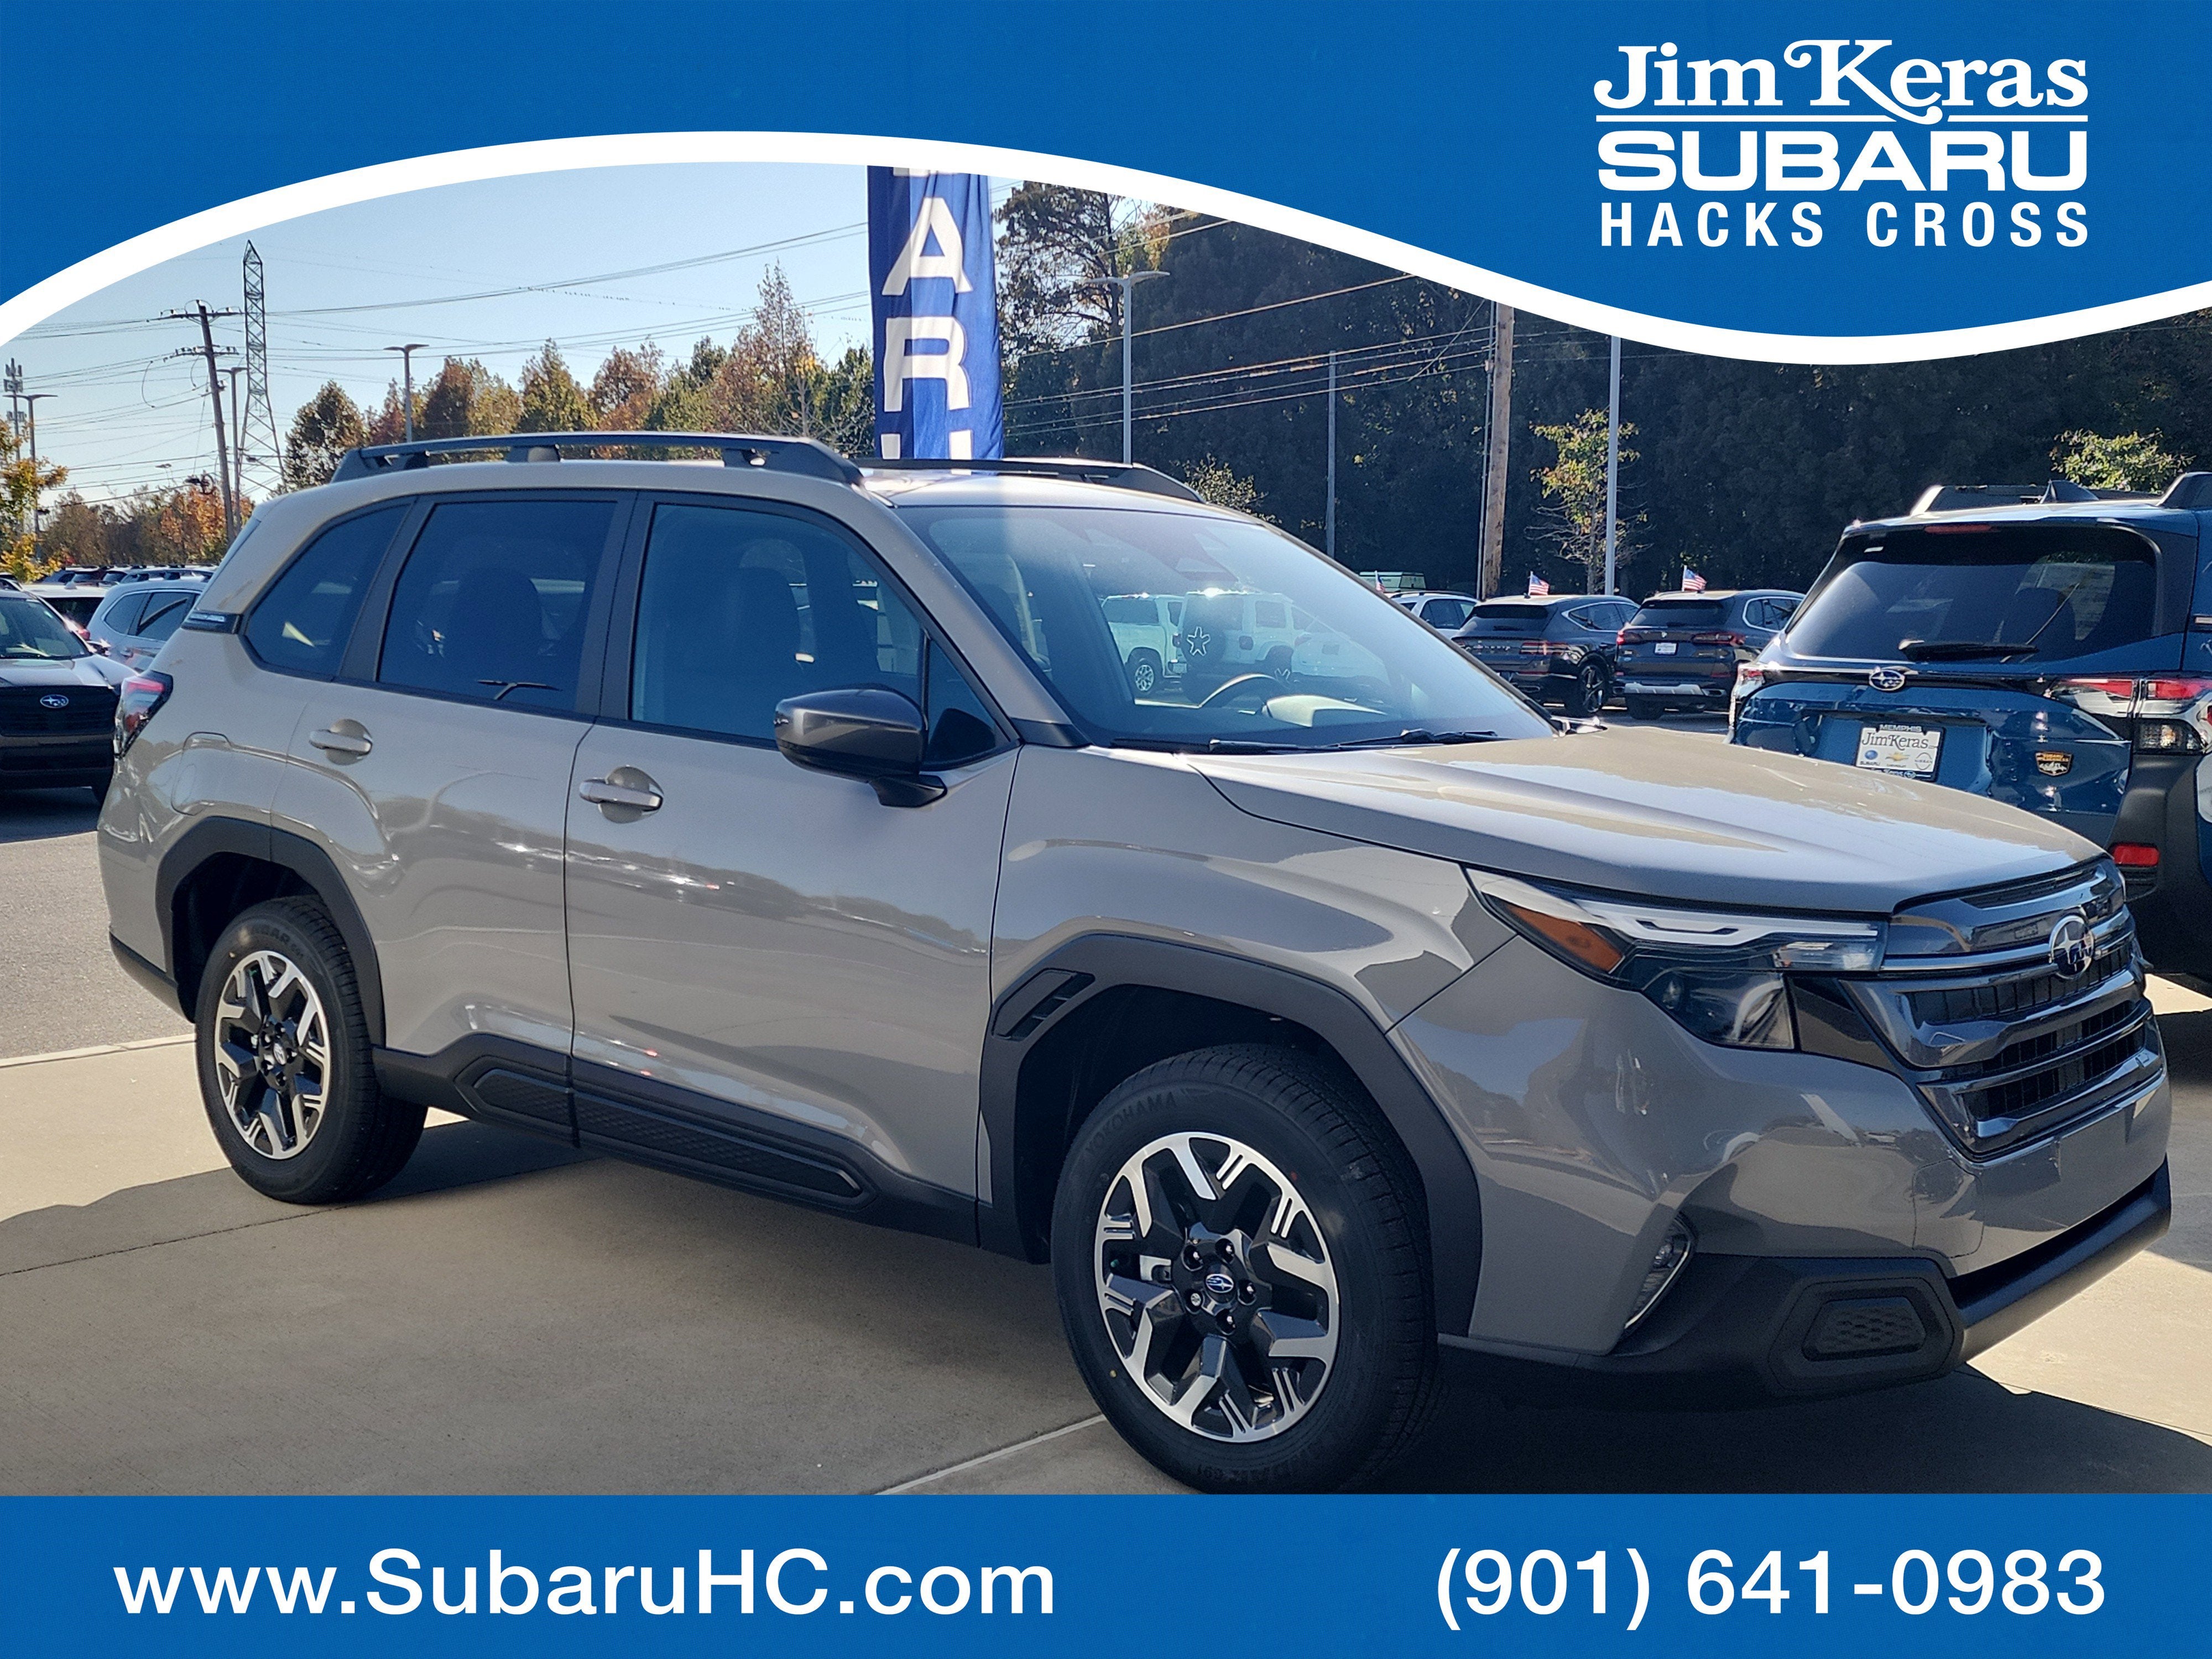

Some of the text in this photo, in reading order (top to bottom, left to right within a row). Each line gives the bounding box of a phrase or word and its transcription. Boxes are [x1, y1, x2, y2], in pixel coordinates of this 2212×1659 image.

[1879, 724, 1922, 732] MEMPHIS
[1862, 732, 1929, 751] Jim Keras
